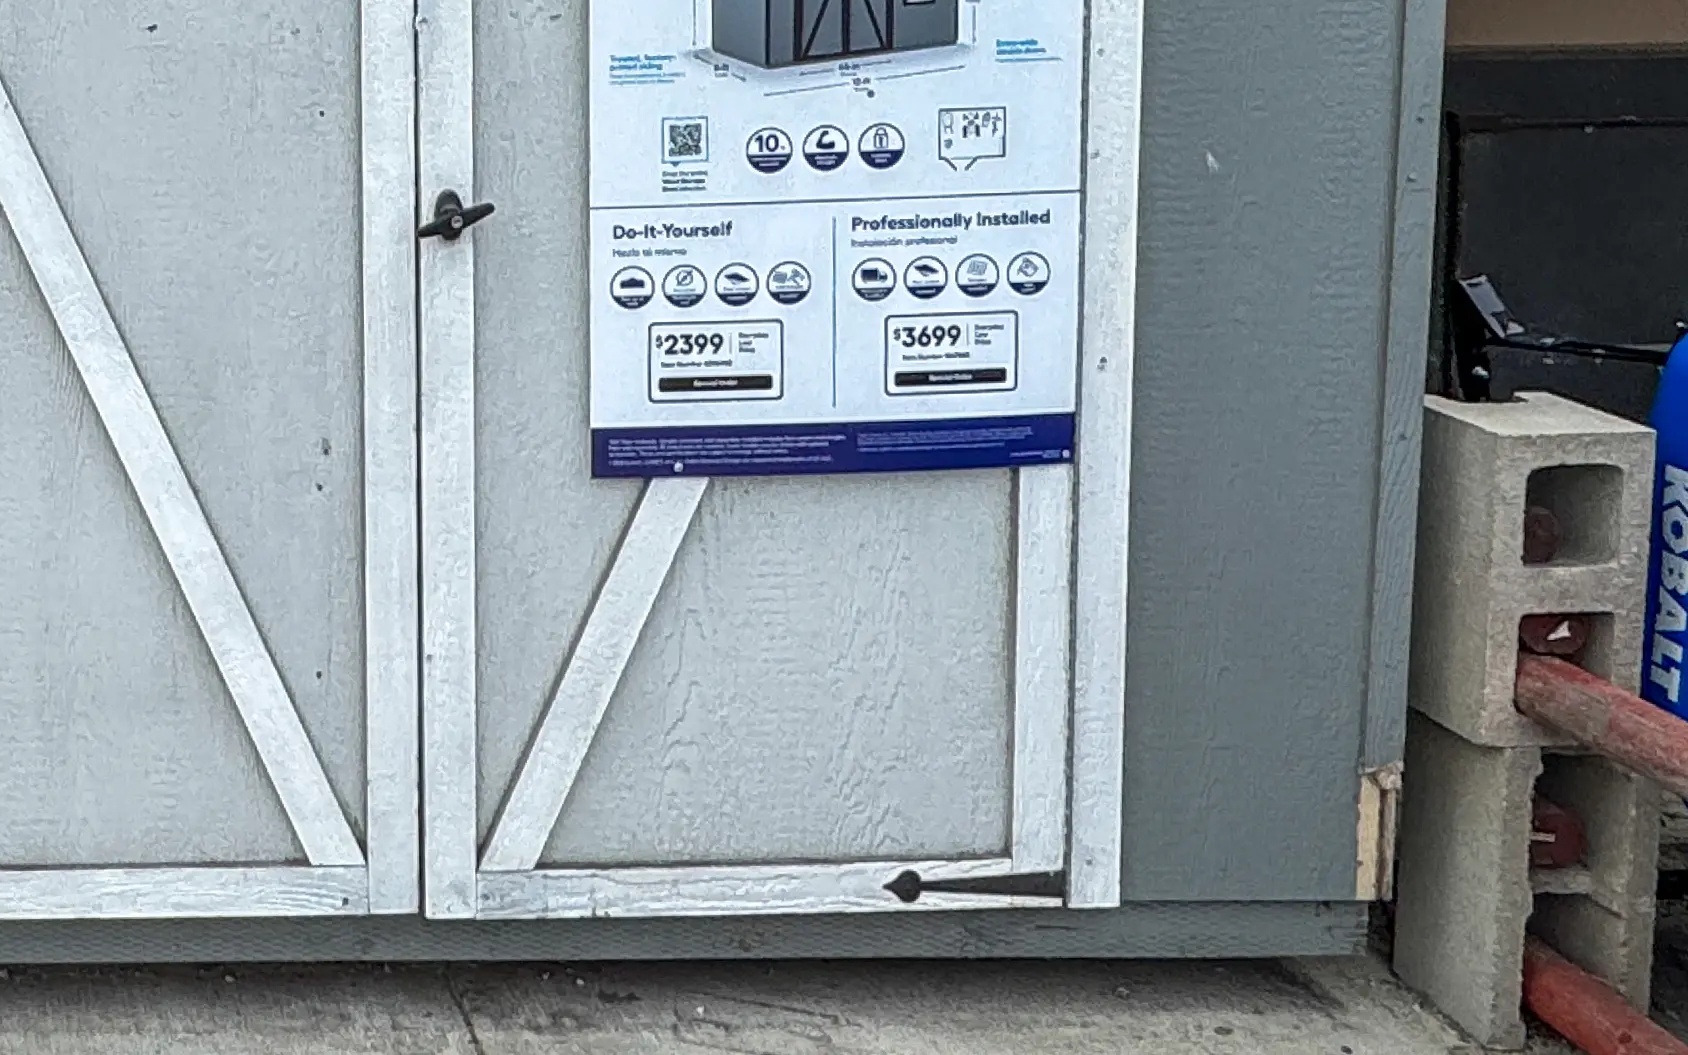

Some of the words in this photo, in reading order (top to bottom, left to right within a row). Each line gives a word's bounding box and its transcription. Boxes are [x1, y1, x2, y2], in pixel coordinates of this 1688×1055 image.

[754, 134, 779, 152] 10
[612, 221, 733, 239] Do-It-Yourself
[851, 212, 973, 231] Professionally
[976, 209, 1051, 227] Installed
[655, 333, 724, 355] $2399
[893, 324, 961, 347] $3699
[1650, 463, 1688, 704] KOBALT
